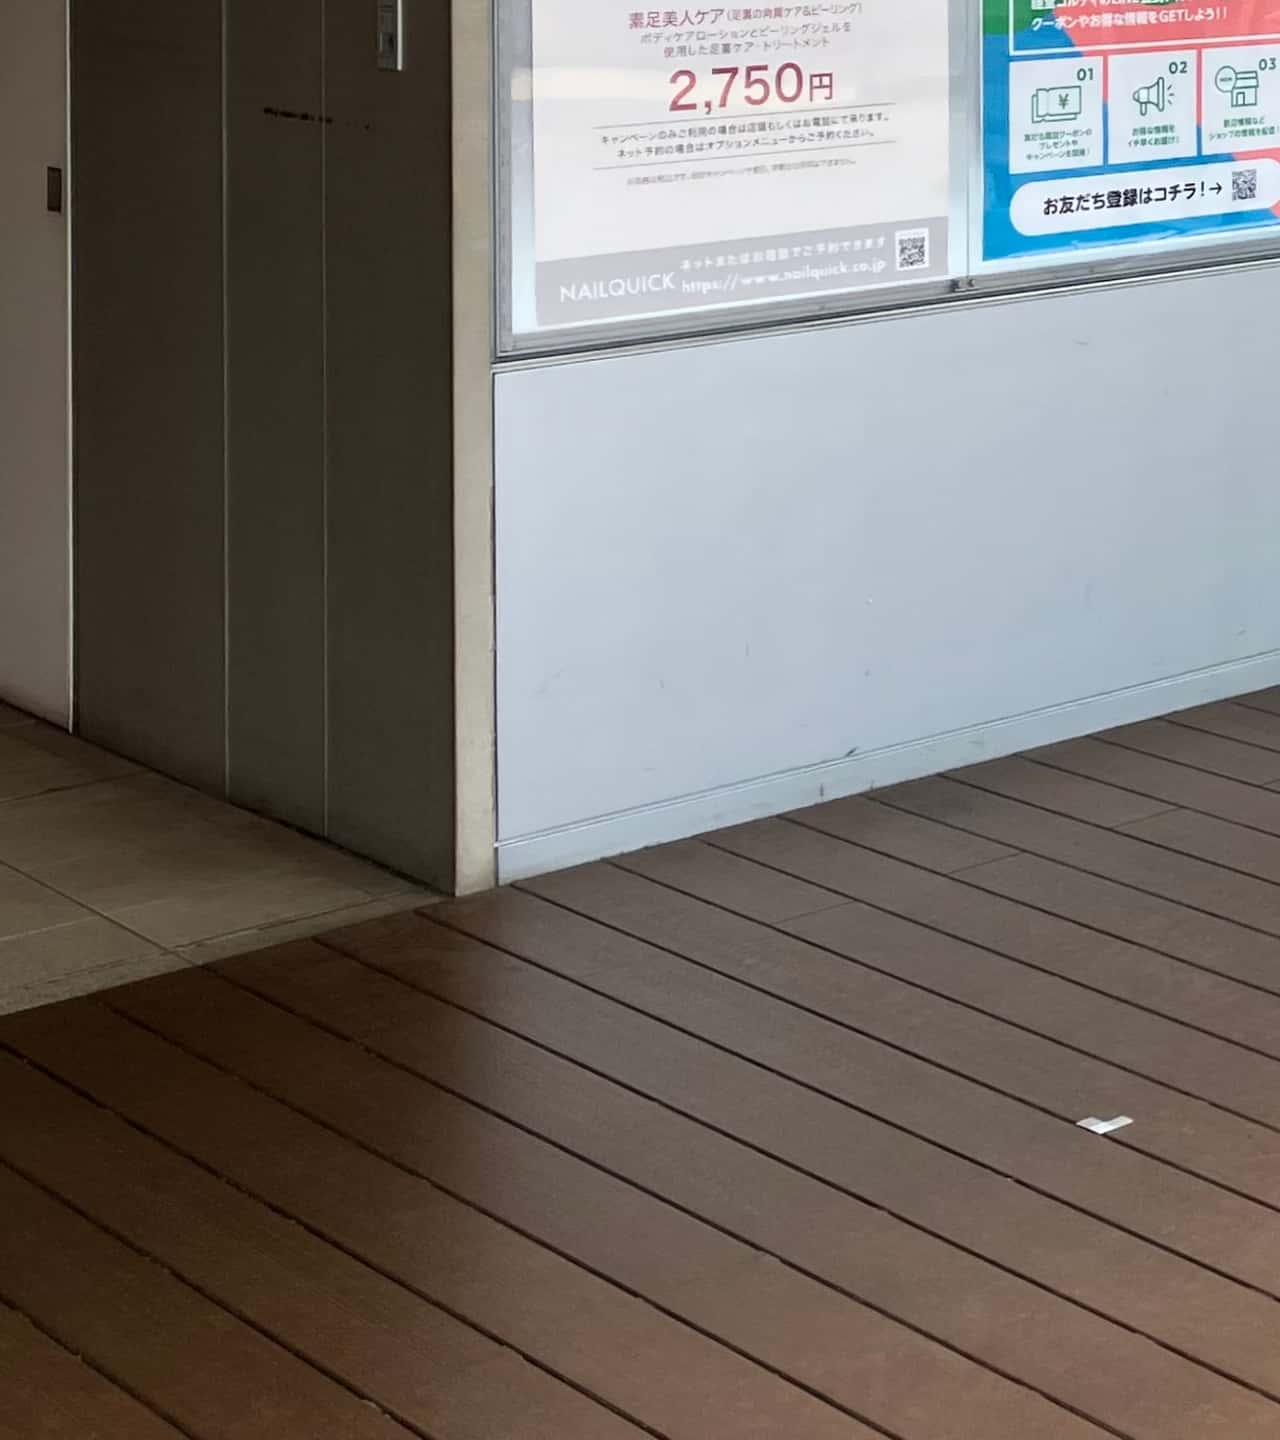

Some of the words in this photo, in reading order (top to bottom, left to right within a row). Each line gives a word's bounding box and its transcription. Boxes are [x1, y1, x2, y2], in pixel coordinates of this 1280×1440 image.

[1076, 68, 1095, 81] 01
[1168, 61, 1188, 74] 02
[1258, 58, 1277, 71] 03
[669, 62, 834, 115] 2,750円
[1043, 183, 1206, 217] お友だち登録はコチラ!
[560, 273, 676, 303] NAILQUICK
